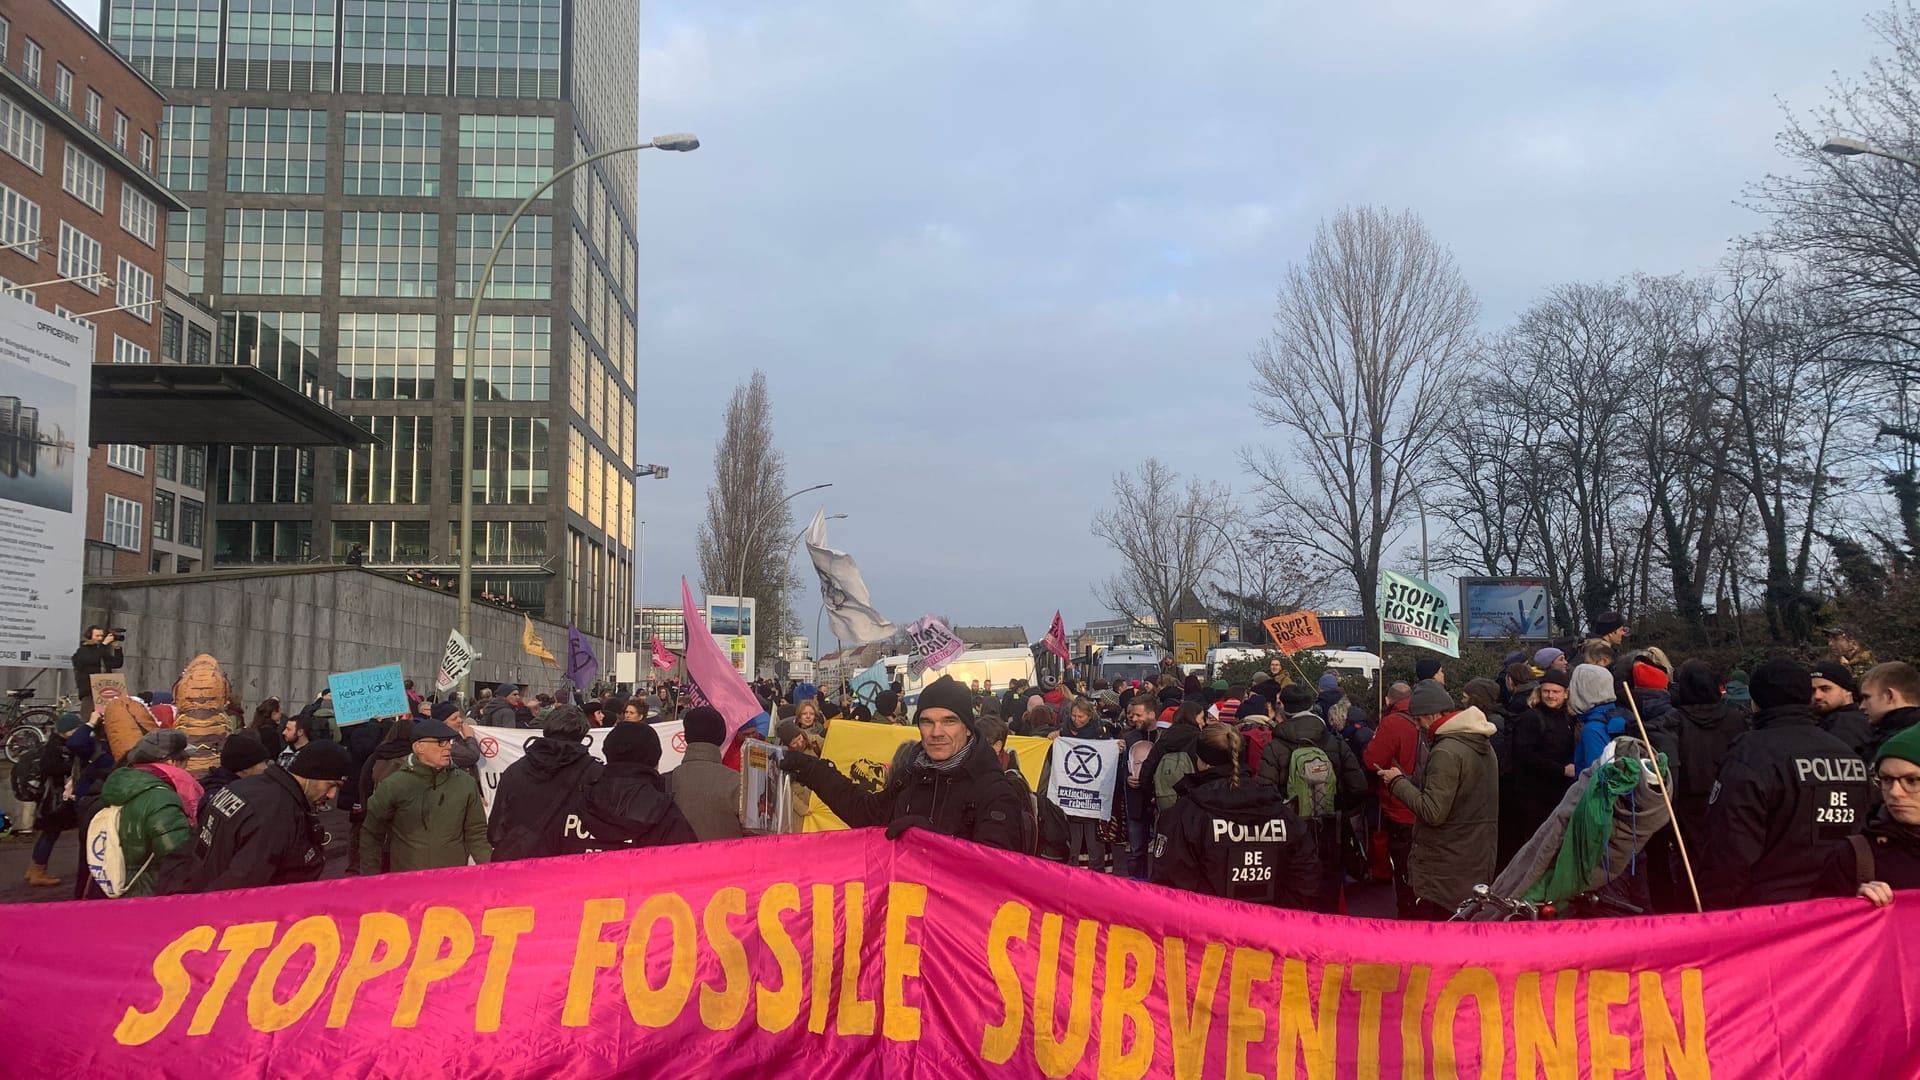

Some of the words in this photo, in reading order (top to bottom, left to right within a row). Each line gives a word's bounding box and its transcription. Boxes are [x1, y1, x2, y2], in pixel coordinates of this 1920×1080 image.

[37, 322, 79, 344] OFFICEFIRST
[1387, 582, 1448, 613] STOPP
[1271, 616, 1308, 633] STOPPT
[1385, 600, 1451, 636] FOSSILE
[367, 680, 394, 693] Kohle
[1795, 757, 1868, 782] POLIZEI
[1059, 788, 1094, 800] extinction
[1830, 791, 1848, 807] BE
[1068, 799, 1101, 810] rebellion
[1816, 807, 1855, 823] 24323
[1212, 818, 1287, 843] POLIZEI
[1244, 851, 1263, 866] BE
[1231, 866, 1272, 882] 24326
[114, 907, 535, 1046] STOPPT
[561, 881, 927, 1042] FOSSILE
[981, 900, 1712, 1080] SUBVENTIONEN
